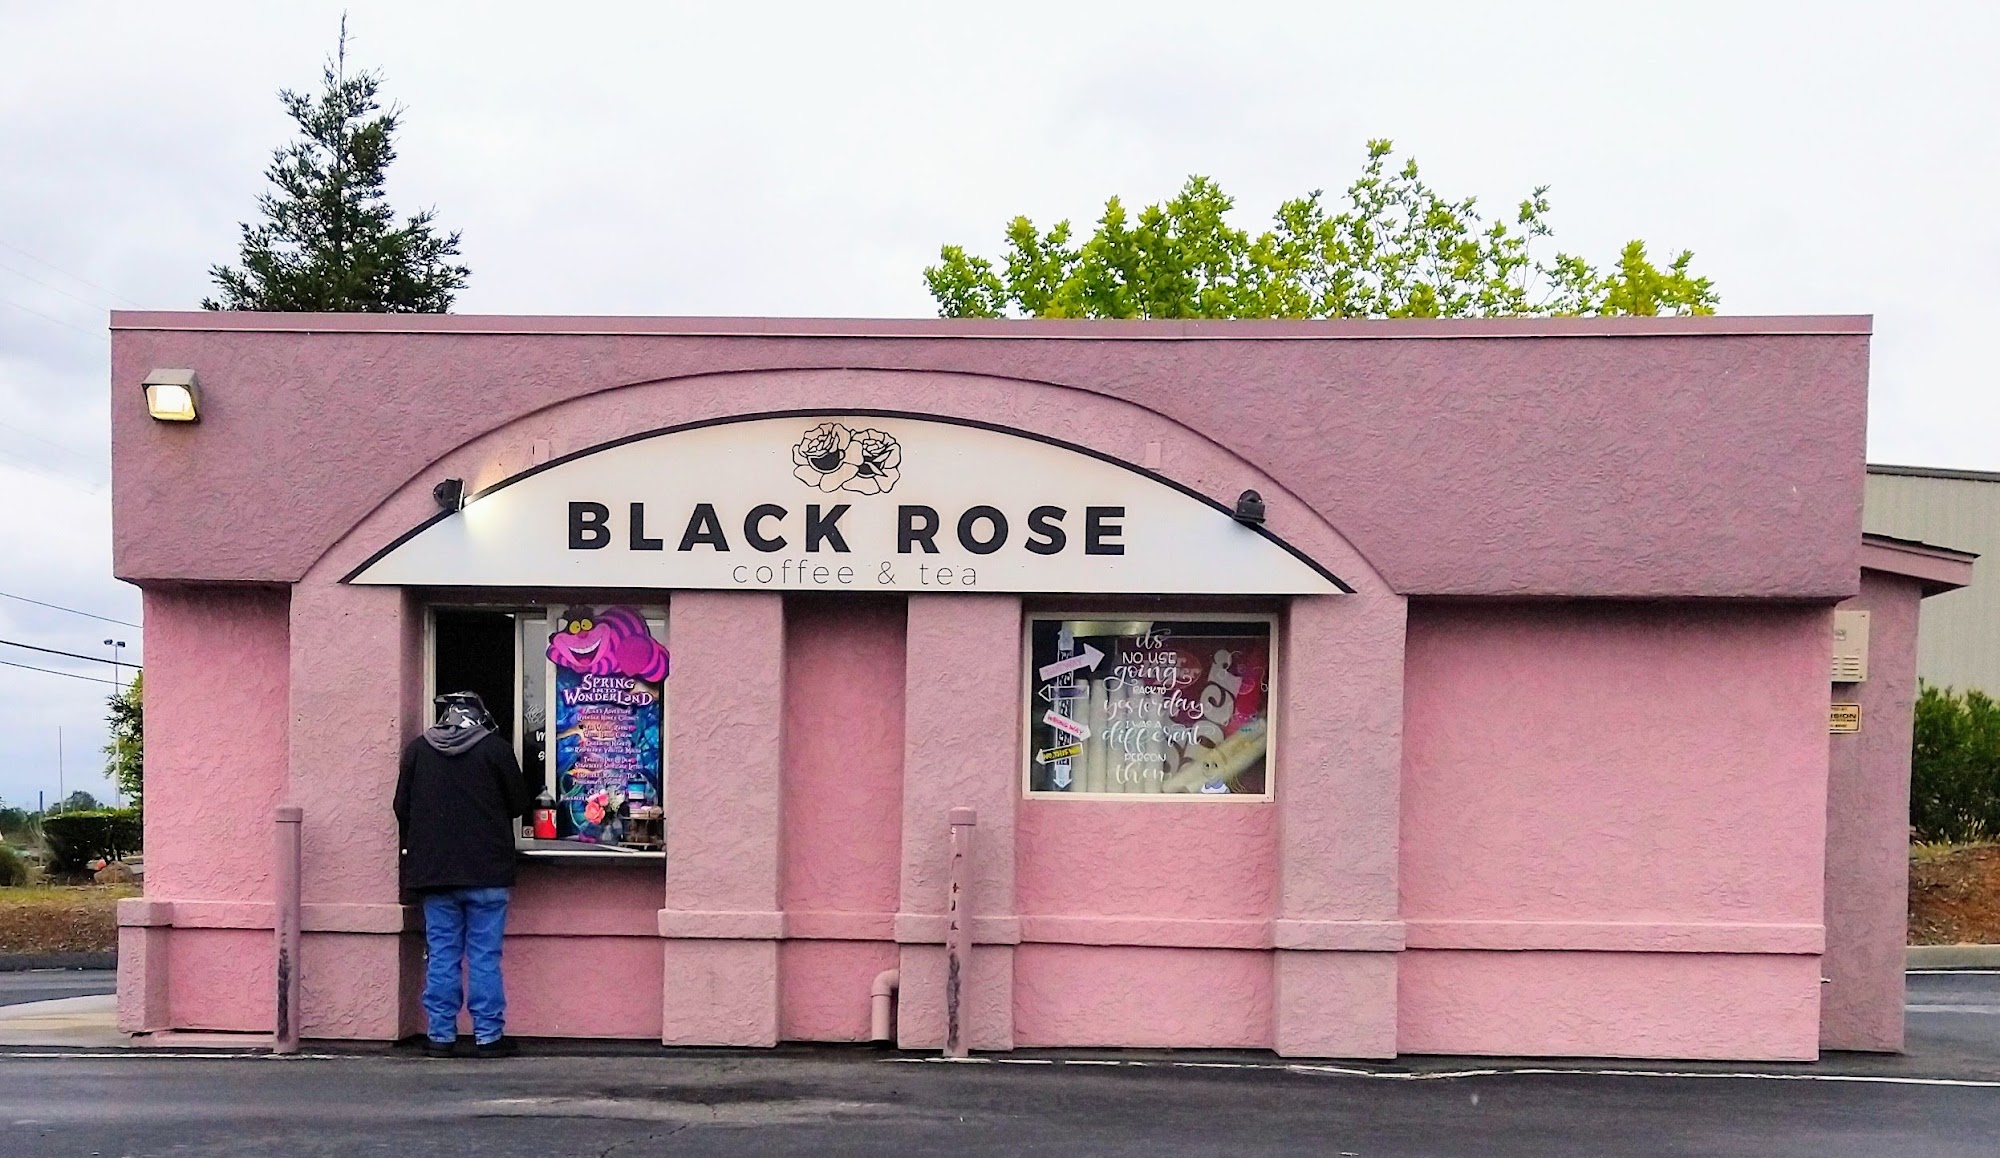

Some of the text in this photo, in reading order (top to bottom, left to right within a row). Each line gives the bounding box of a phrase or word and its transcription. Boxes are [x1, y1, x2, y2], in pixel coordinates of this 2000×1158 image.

[568, 501, 1126, 556] BLACK ROSE
[732, 559, 978, 587] coffee & tea
[1122, 651, 1178, 665] NO USE
[582, 673, 635, 691] SPRING
[1103, 665, 1193, 692] going
[1103, 689, 1204, 721] yesterday
[1102, 720, 1201, 753] different
[1124, 753, 1167, 762] PERSON
